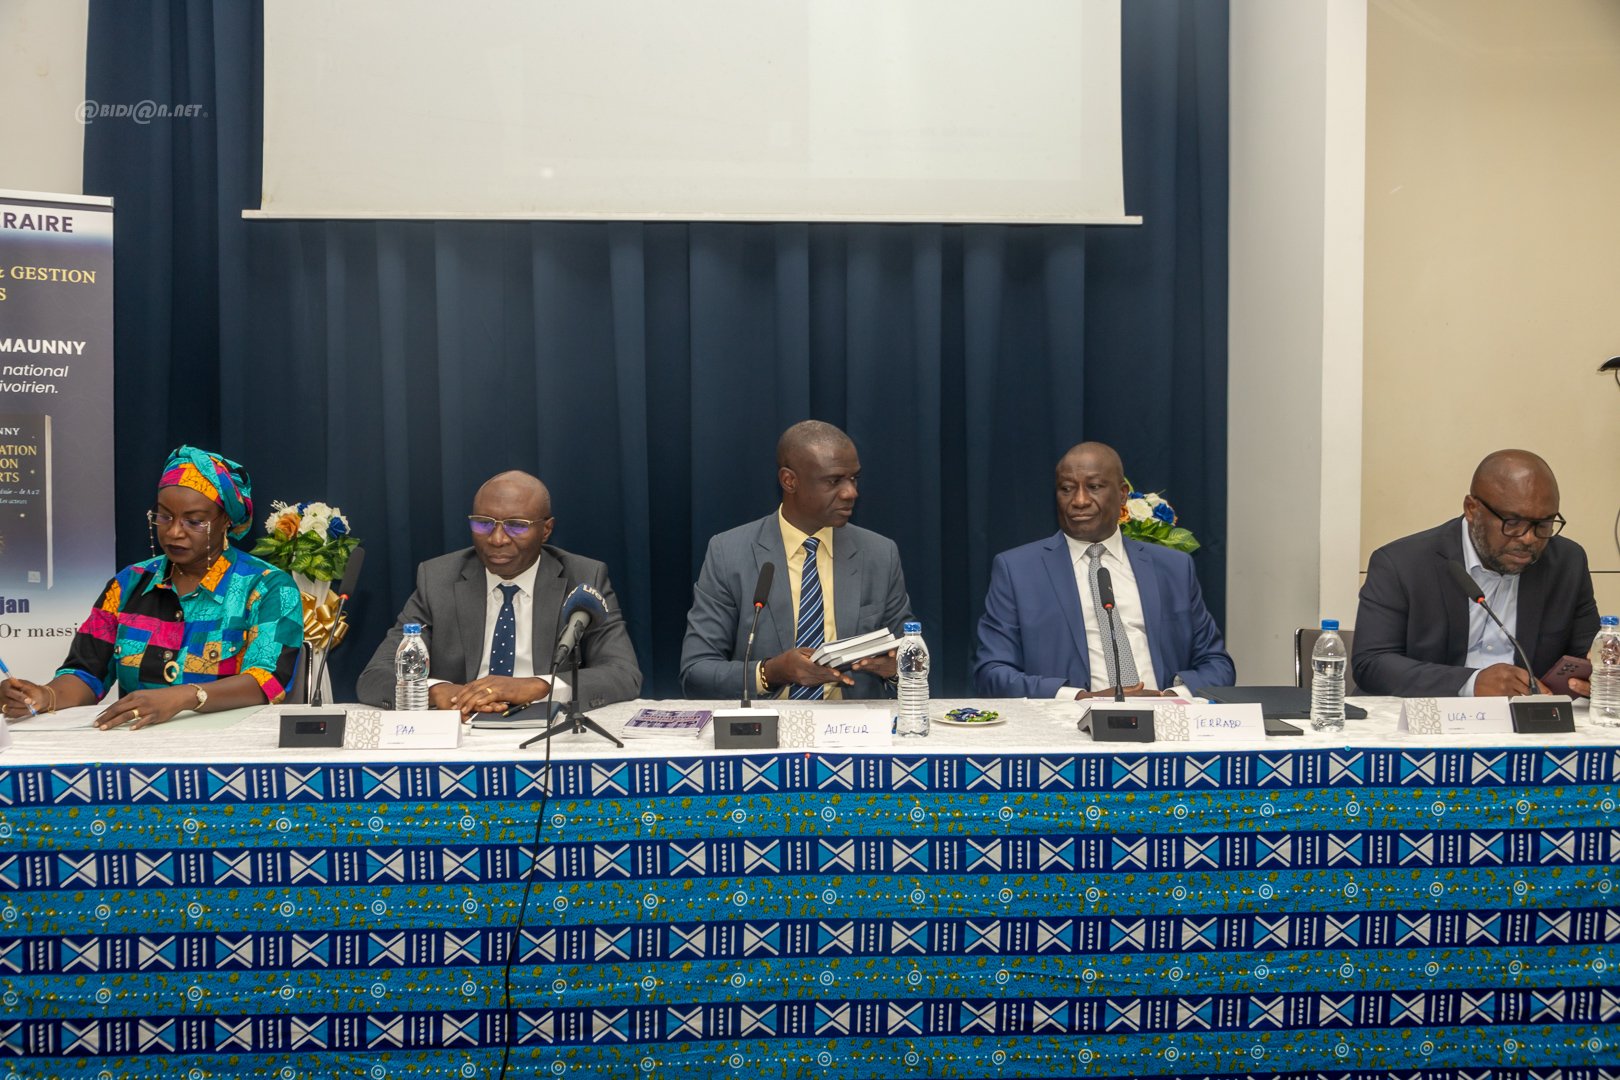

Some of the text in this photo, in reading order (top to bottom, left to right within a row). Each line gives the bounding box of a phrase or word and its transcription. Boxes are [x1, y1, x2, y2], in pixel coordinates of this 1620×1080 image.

[0, 211, 73, 233] RAIRE
[10, 266, 96, 283] GESTION
[3, 364, 69, 378] national
[825, 723, 869, 735] AUTEUR
